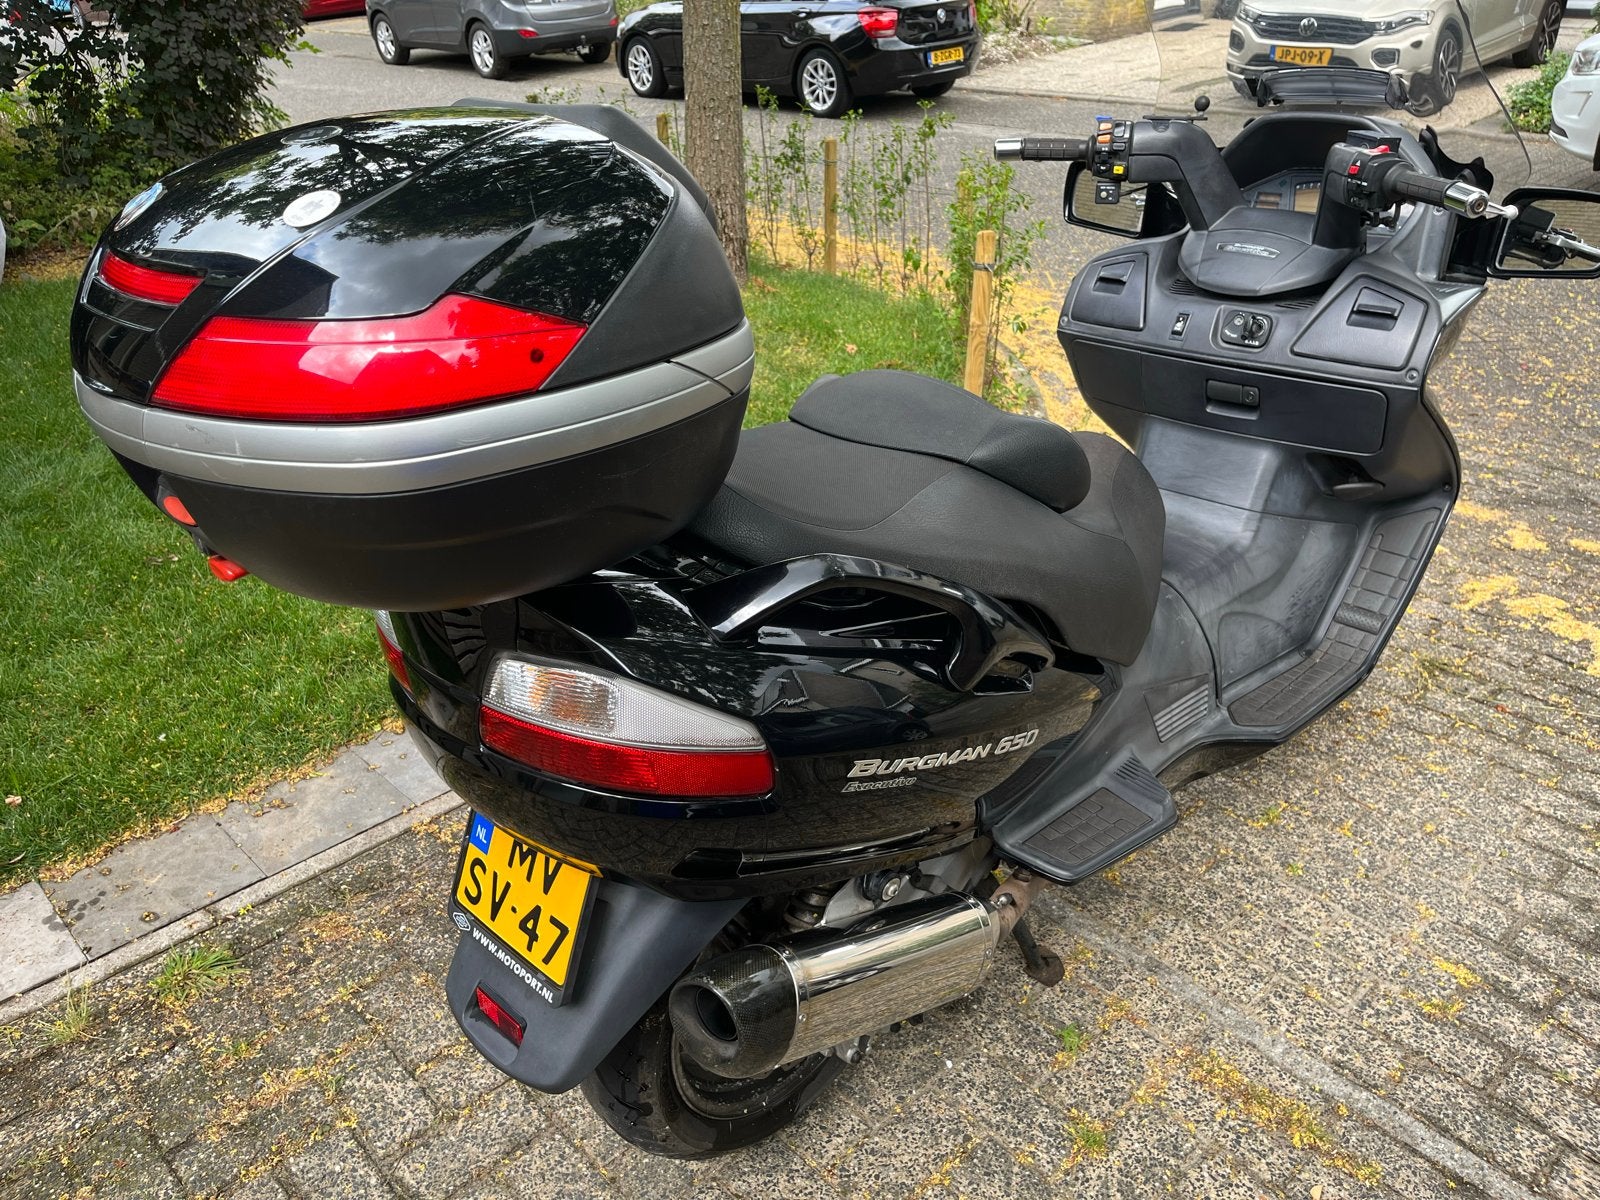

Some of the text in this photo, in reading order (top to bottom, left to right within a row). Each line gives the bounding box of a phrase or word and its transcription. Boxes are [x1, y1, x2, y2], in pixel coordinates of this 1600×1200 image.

[1278, 48, 1326, 64] JPJ-09-X
[847, 728, 1040, 778] BURGMAN 650
[841, 776, 918, 793] Executive
[475, 824, 488, 844] NL
[507, 838, 563, 896] MV
[464, 857, 570, 966] SV-47
[472, 927, 554, 1004] WWW.MOTOPORT.NL
